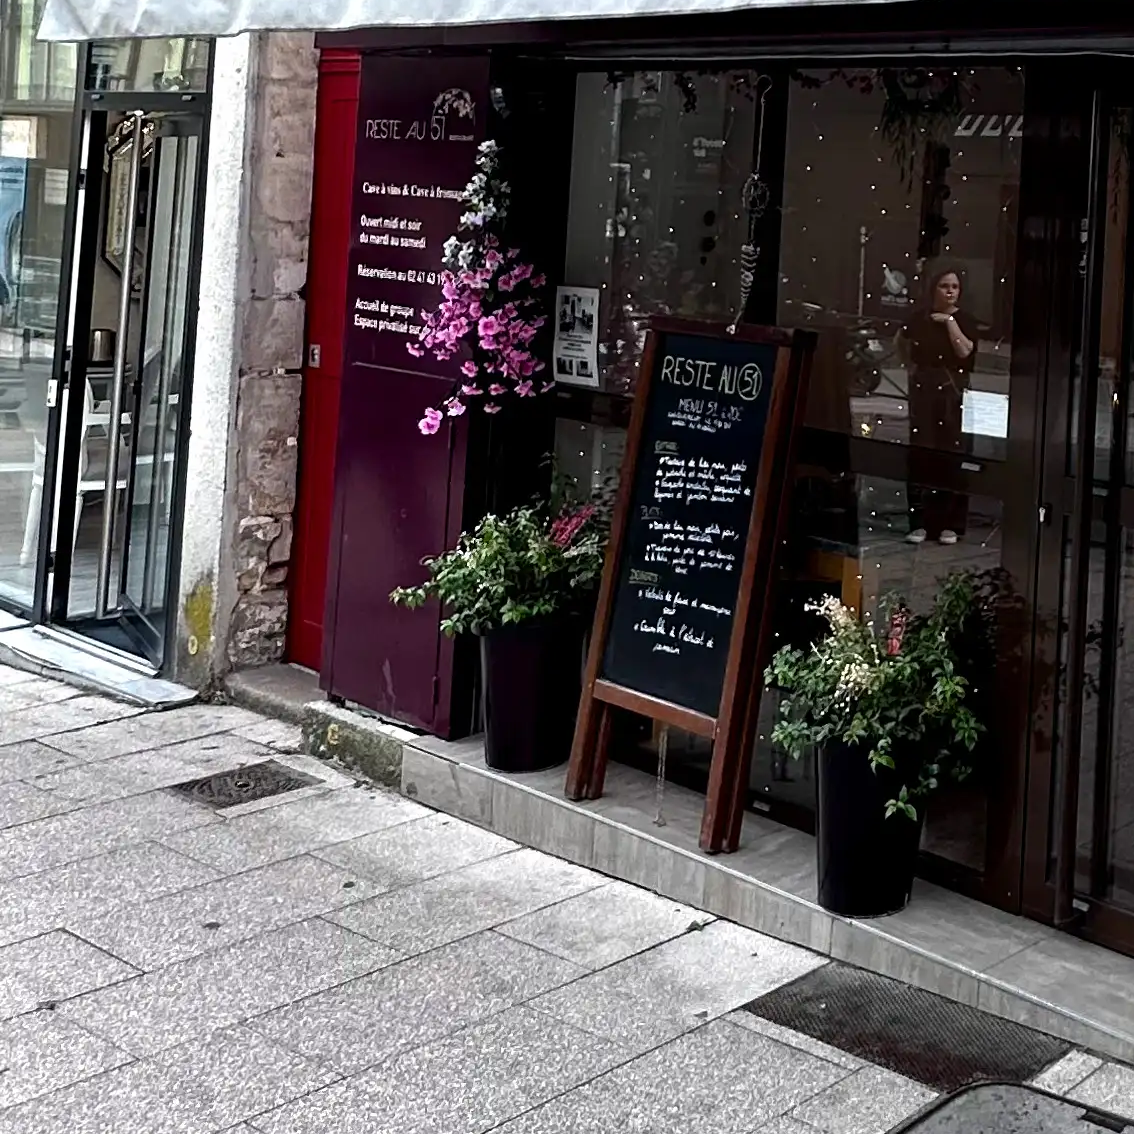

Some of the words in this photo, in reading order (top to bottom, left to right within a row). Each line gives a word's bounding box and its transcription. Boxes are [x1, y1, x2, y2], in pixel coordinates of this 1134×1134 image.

[365, 119, 402, 139] RESTE
[405, 120, 427, 140] AU
[430, 115, 446, 141] 51
[362, 181, 380, 194] Cave
[360, 214, 383, 228] Ouvert
[661, 355, 717, 391] RESTE
[718, 364, 738, 395] AU
[740, 367, 761, 397] 51
[678, 398, 704, 414] MENU
